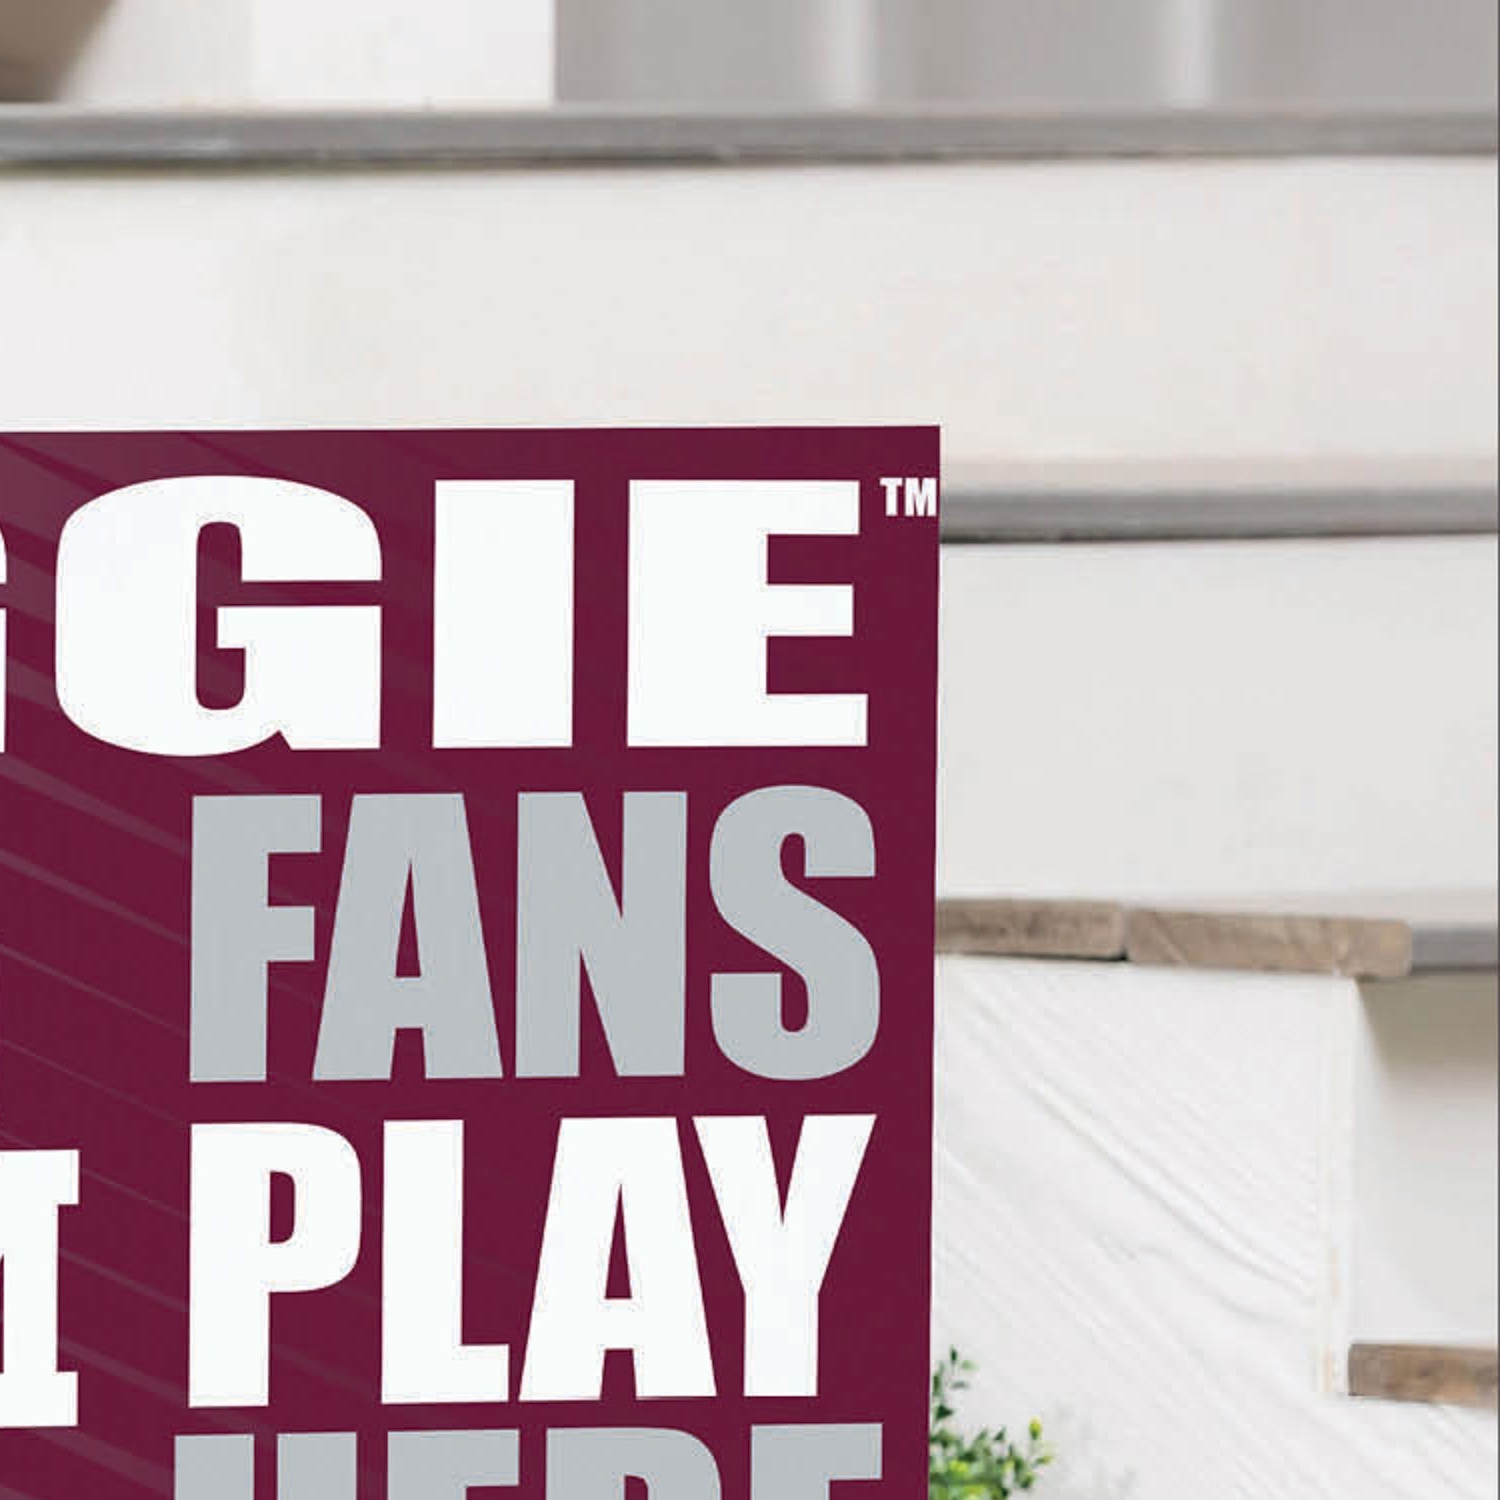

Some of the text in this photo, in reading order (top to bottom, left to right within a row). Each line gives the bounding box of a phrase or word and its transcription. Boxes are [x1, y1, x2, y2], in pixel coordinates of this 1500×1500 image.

[879, 477, 938, 517] TM
[190, 786, 879, 1083] FANS
[189, 1114, 876, 1408] PLAY
